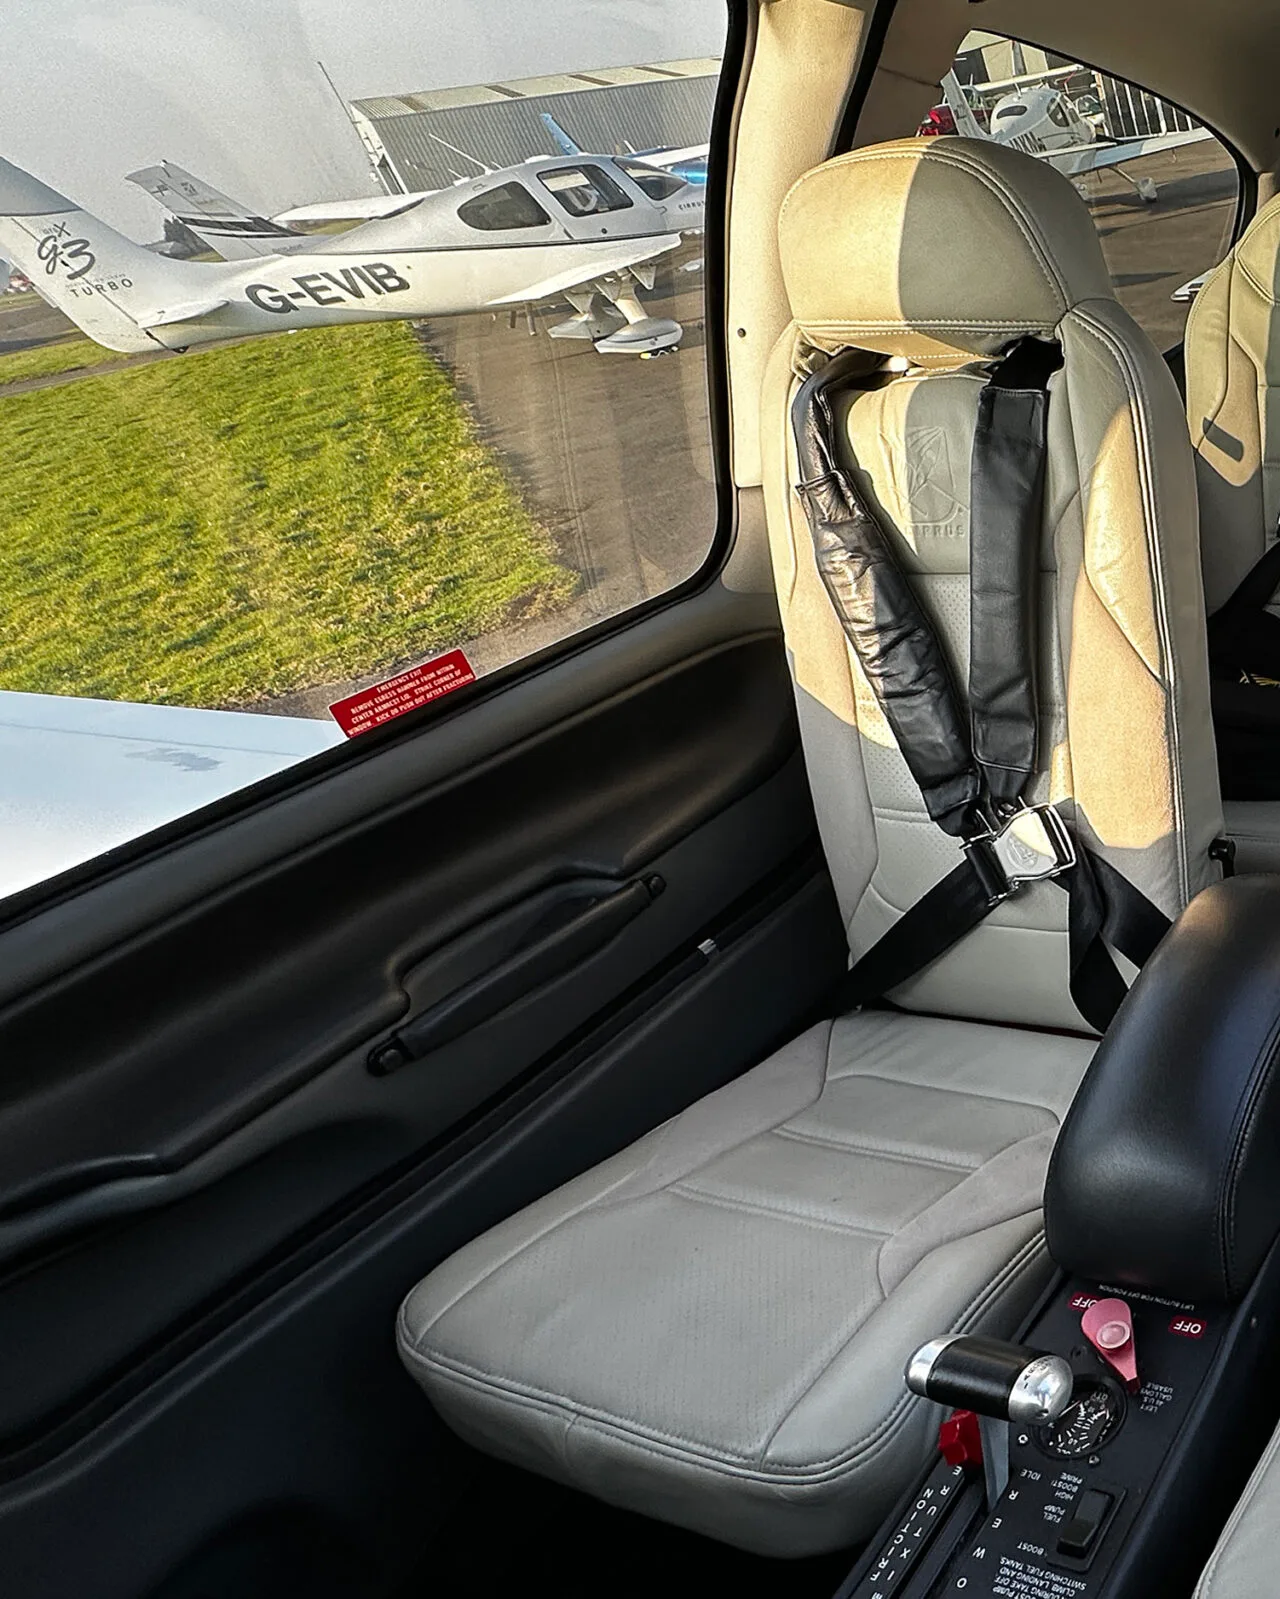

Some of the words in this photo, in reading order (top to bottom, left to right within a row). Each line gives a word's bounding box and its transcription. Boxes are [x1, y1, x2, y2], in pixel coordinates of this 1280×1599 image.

[70, 279, 133, 297] TURBO
[245, 262, 411, 314] G-EVIB
[409, 668, 422, 678] EXIT
[350, 699, 374, 714] REMOVE
[419, 671, 436, 682] FROM
[350, 709, 374, 724] CENTER
[432, 672, 454, 686] CORNER
[375, 711, 390, 722] KICK
[424, 686, 443, 699] AFTER
[1154, 1296, 1180, 1307] BUTTON
[1173, 1320, 1203, 1335] OFF
[1020, 1468, 1041, 1481] IDLE
[1059, 1471, 1083, 1484] PRIME
[1054, 1489, 1074, 1500] HIGH
[1043, 1502, 1065, 1514] PUMP
[1042, 1511, 1061, 1523] FUEL
[870, 1487, 934, 1582] FRICTION
[956, 1489, 1020, 1589] OWER
[1017, 1540, 1044, 1556] BOOST
[999, 1556, 1024, 1570] TANKS
[1025, 1564, 1044, 1576] FUEL
[999, 1566, 1016, 1577] AND
[1009, 1579, 1029, 1592] TAKE
[1015, 1570, 1049, 1588] LANDING
[1044, 1570, 1086, 1590] SWITCHING
